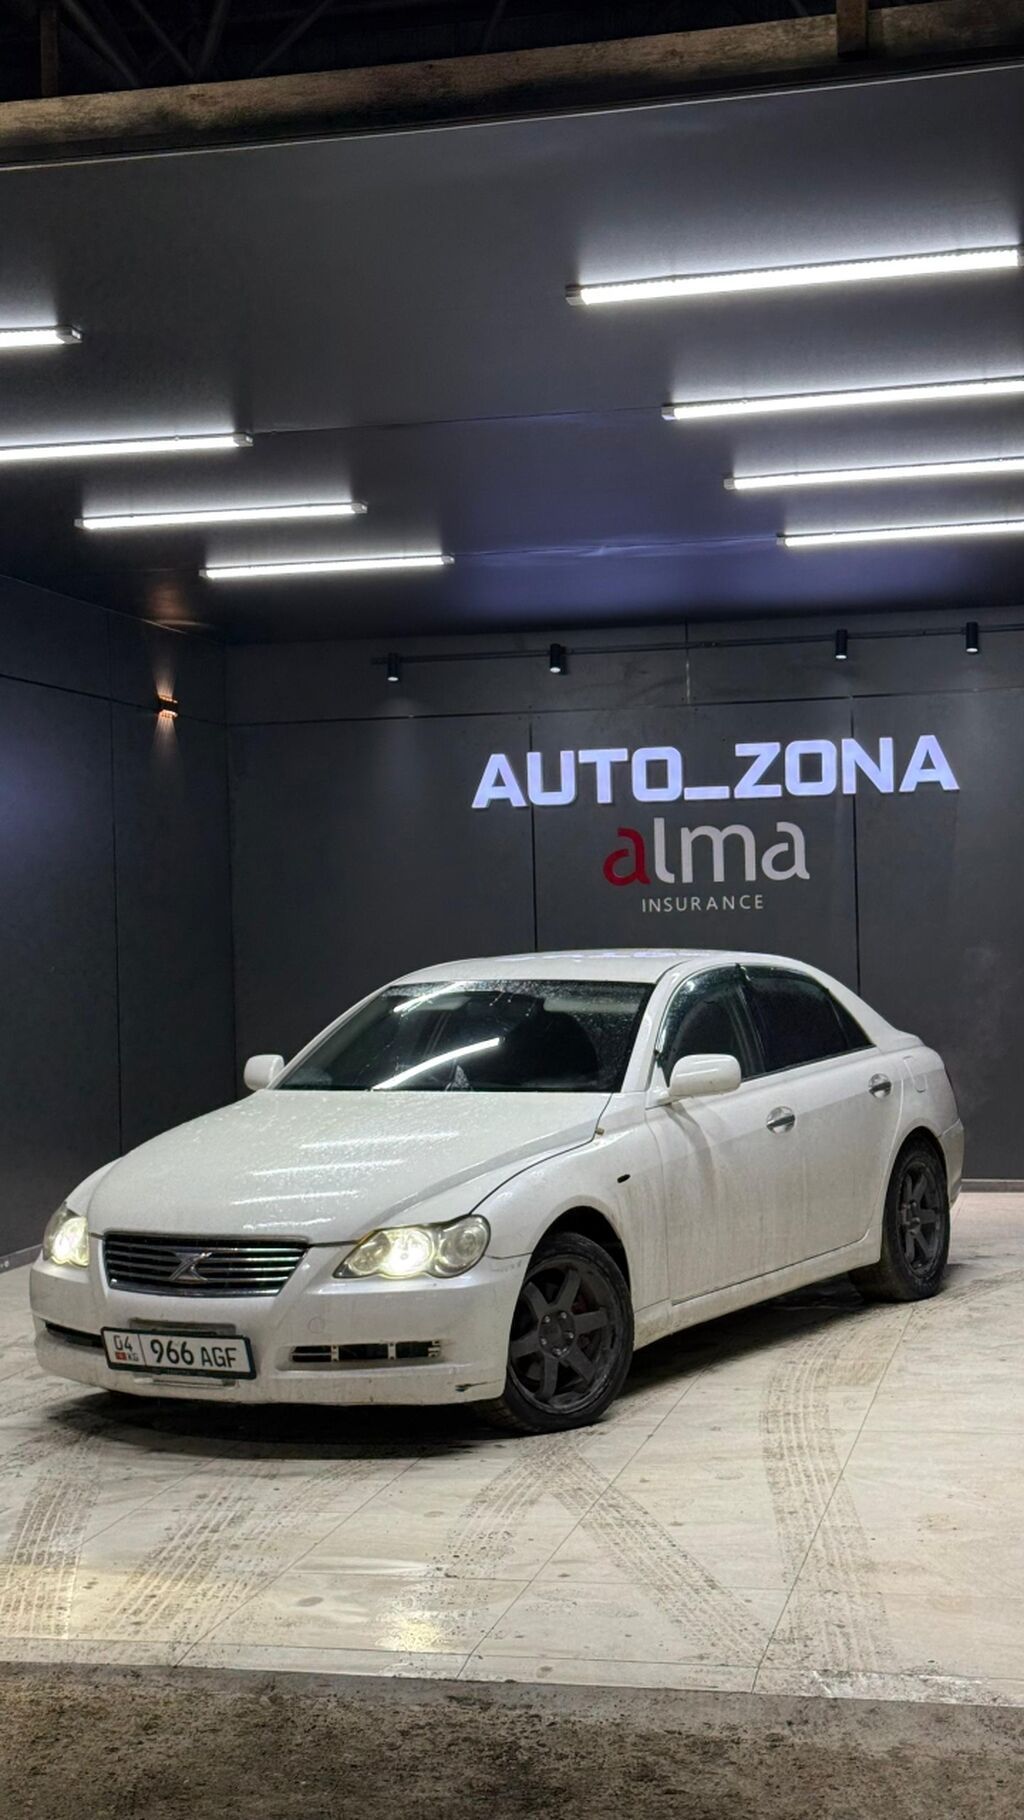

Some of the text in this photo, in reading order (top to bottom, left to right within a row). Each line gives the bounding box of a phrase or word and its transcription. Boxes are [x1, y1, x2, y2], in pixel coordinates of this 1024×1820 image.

[472, 735, 960, 808] AUTO_ZONA
[603, 817, 811, 886] alma
[641, 894, 765, 913] INSURANCE
[113, 1335, 237, 1369] 04 966 AGF
